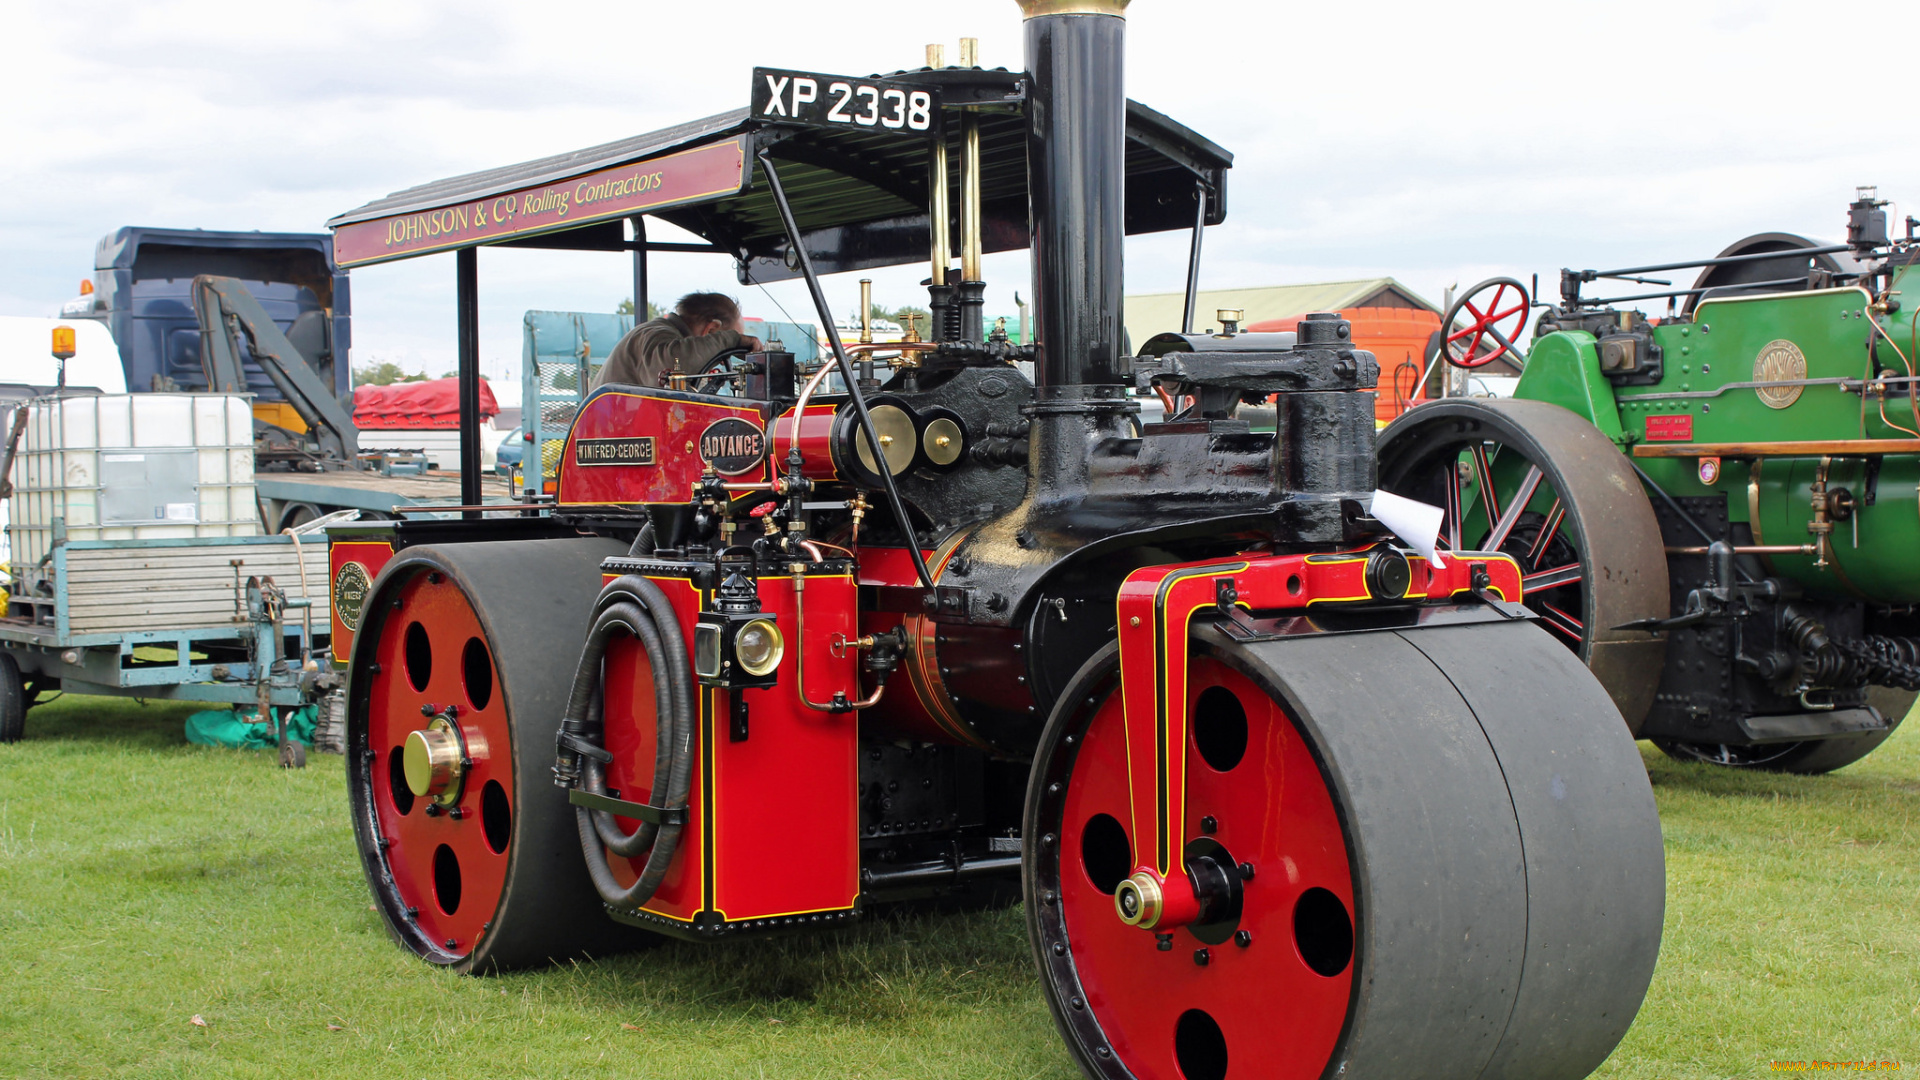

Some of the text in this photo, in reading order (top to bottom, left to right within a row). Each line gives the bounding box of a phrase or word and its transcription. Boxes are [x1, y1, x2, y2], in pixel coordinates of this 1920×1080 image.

[763, 74, 931, 131] XP 2338
[385, 206, 469, 245] JOHNSON
[474, 202, 487, 227] &
[522, 189, 570, 216] Rolling
[575, 171, 663, 205] Contractors
[704, 434, 760, 458] ADVANCE
